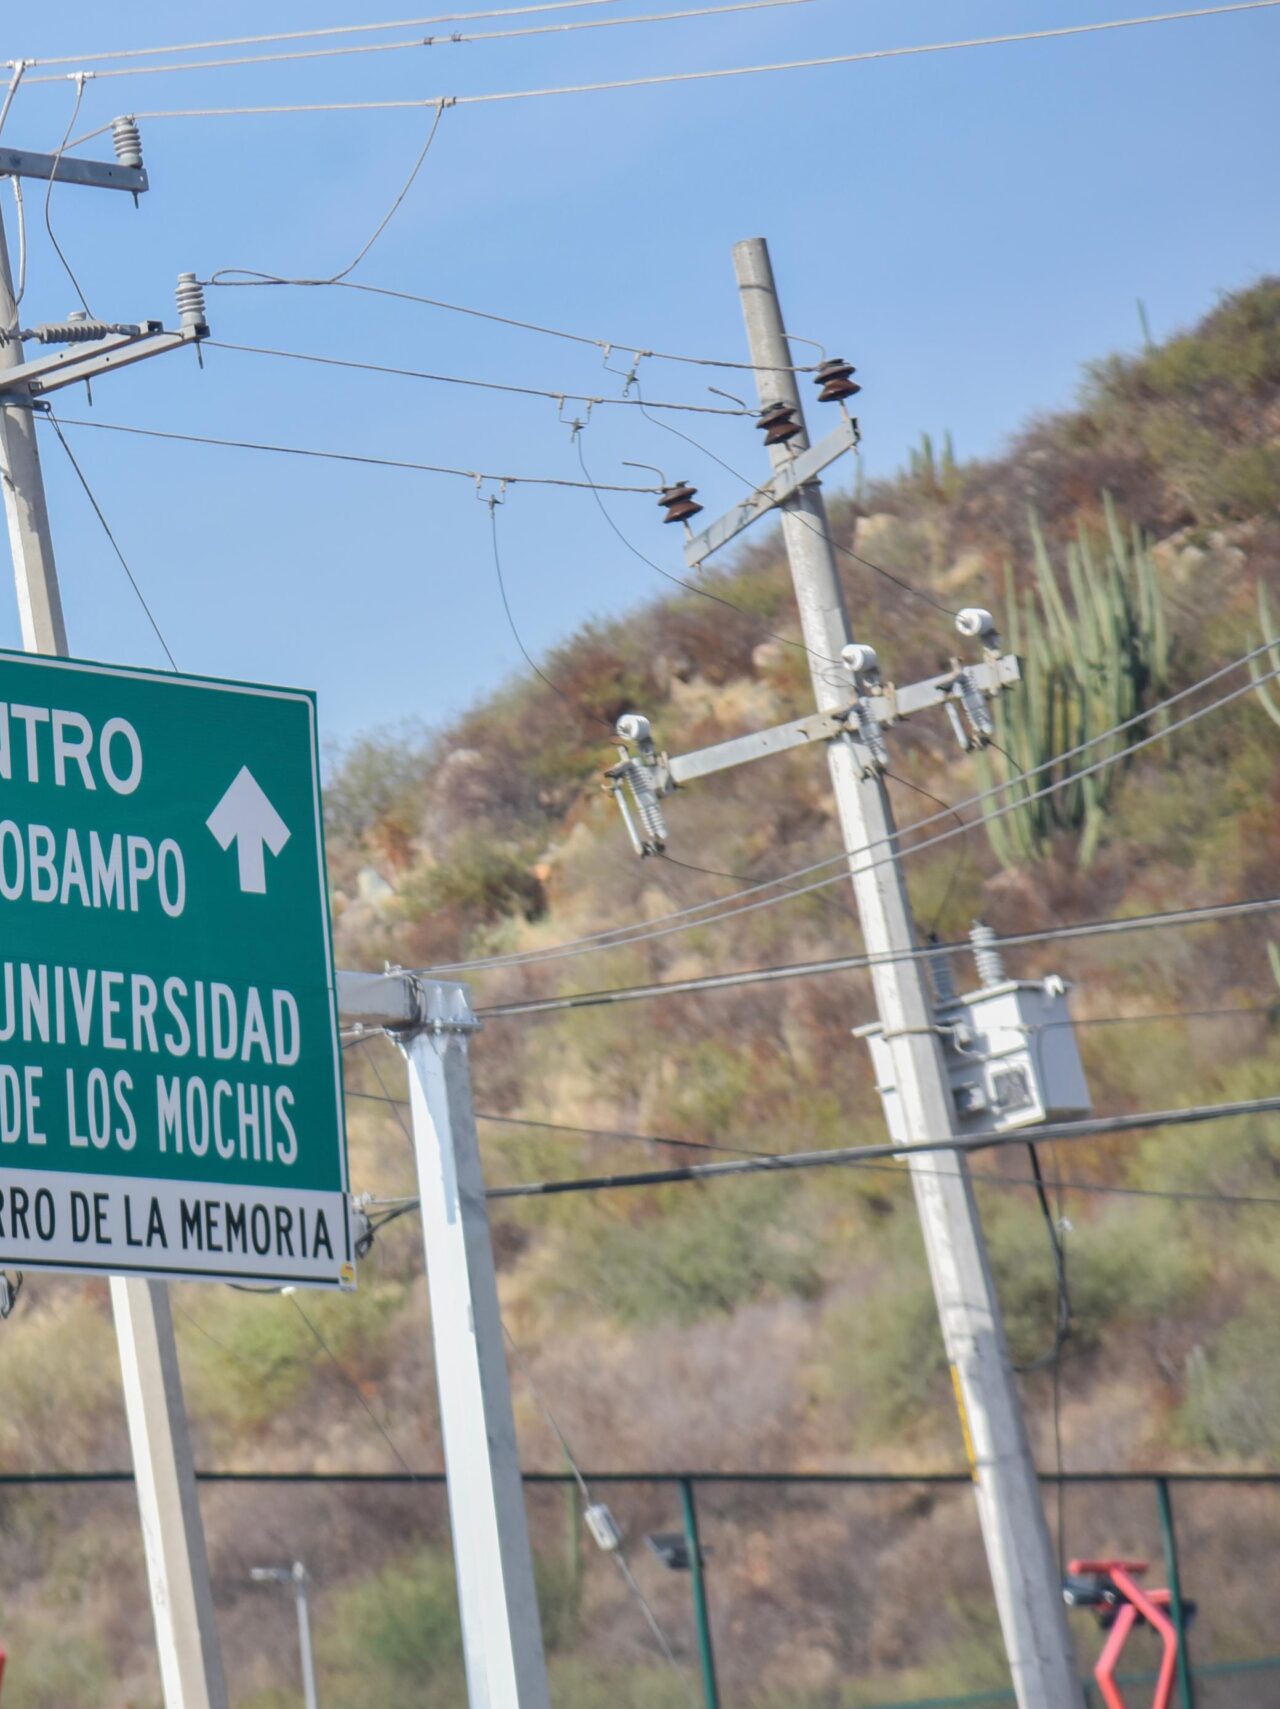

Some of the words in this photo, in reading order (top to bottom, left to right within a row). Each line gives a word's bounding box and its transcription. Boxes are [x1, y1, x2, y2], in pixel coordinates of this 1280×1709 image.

[66, 1067, 138, 1151] LOS
[156, 1074, 299, 1166] MOCHIS
[70, 1190, 113, 1245] DE
[124, 1194, 169, 1249] LA
[179, 1198, 334, 1260] MEMORIA
